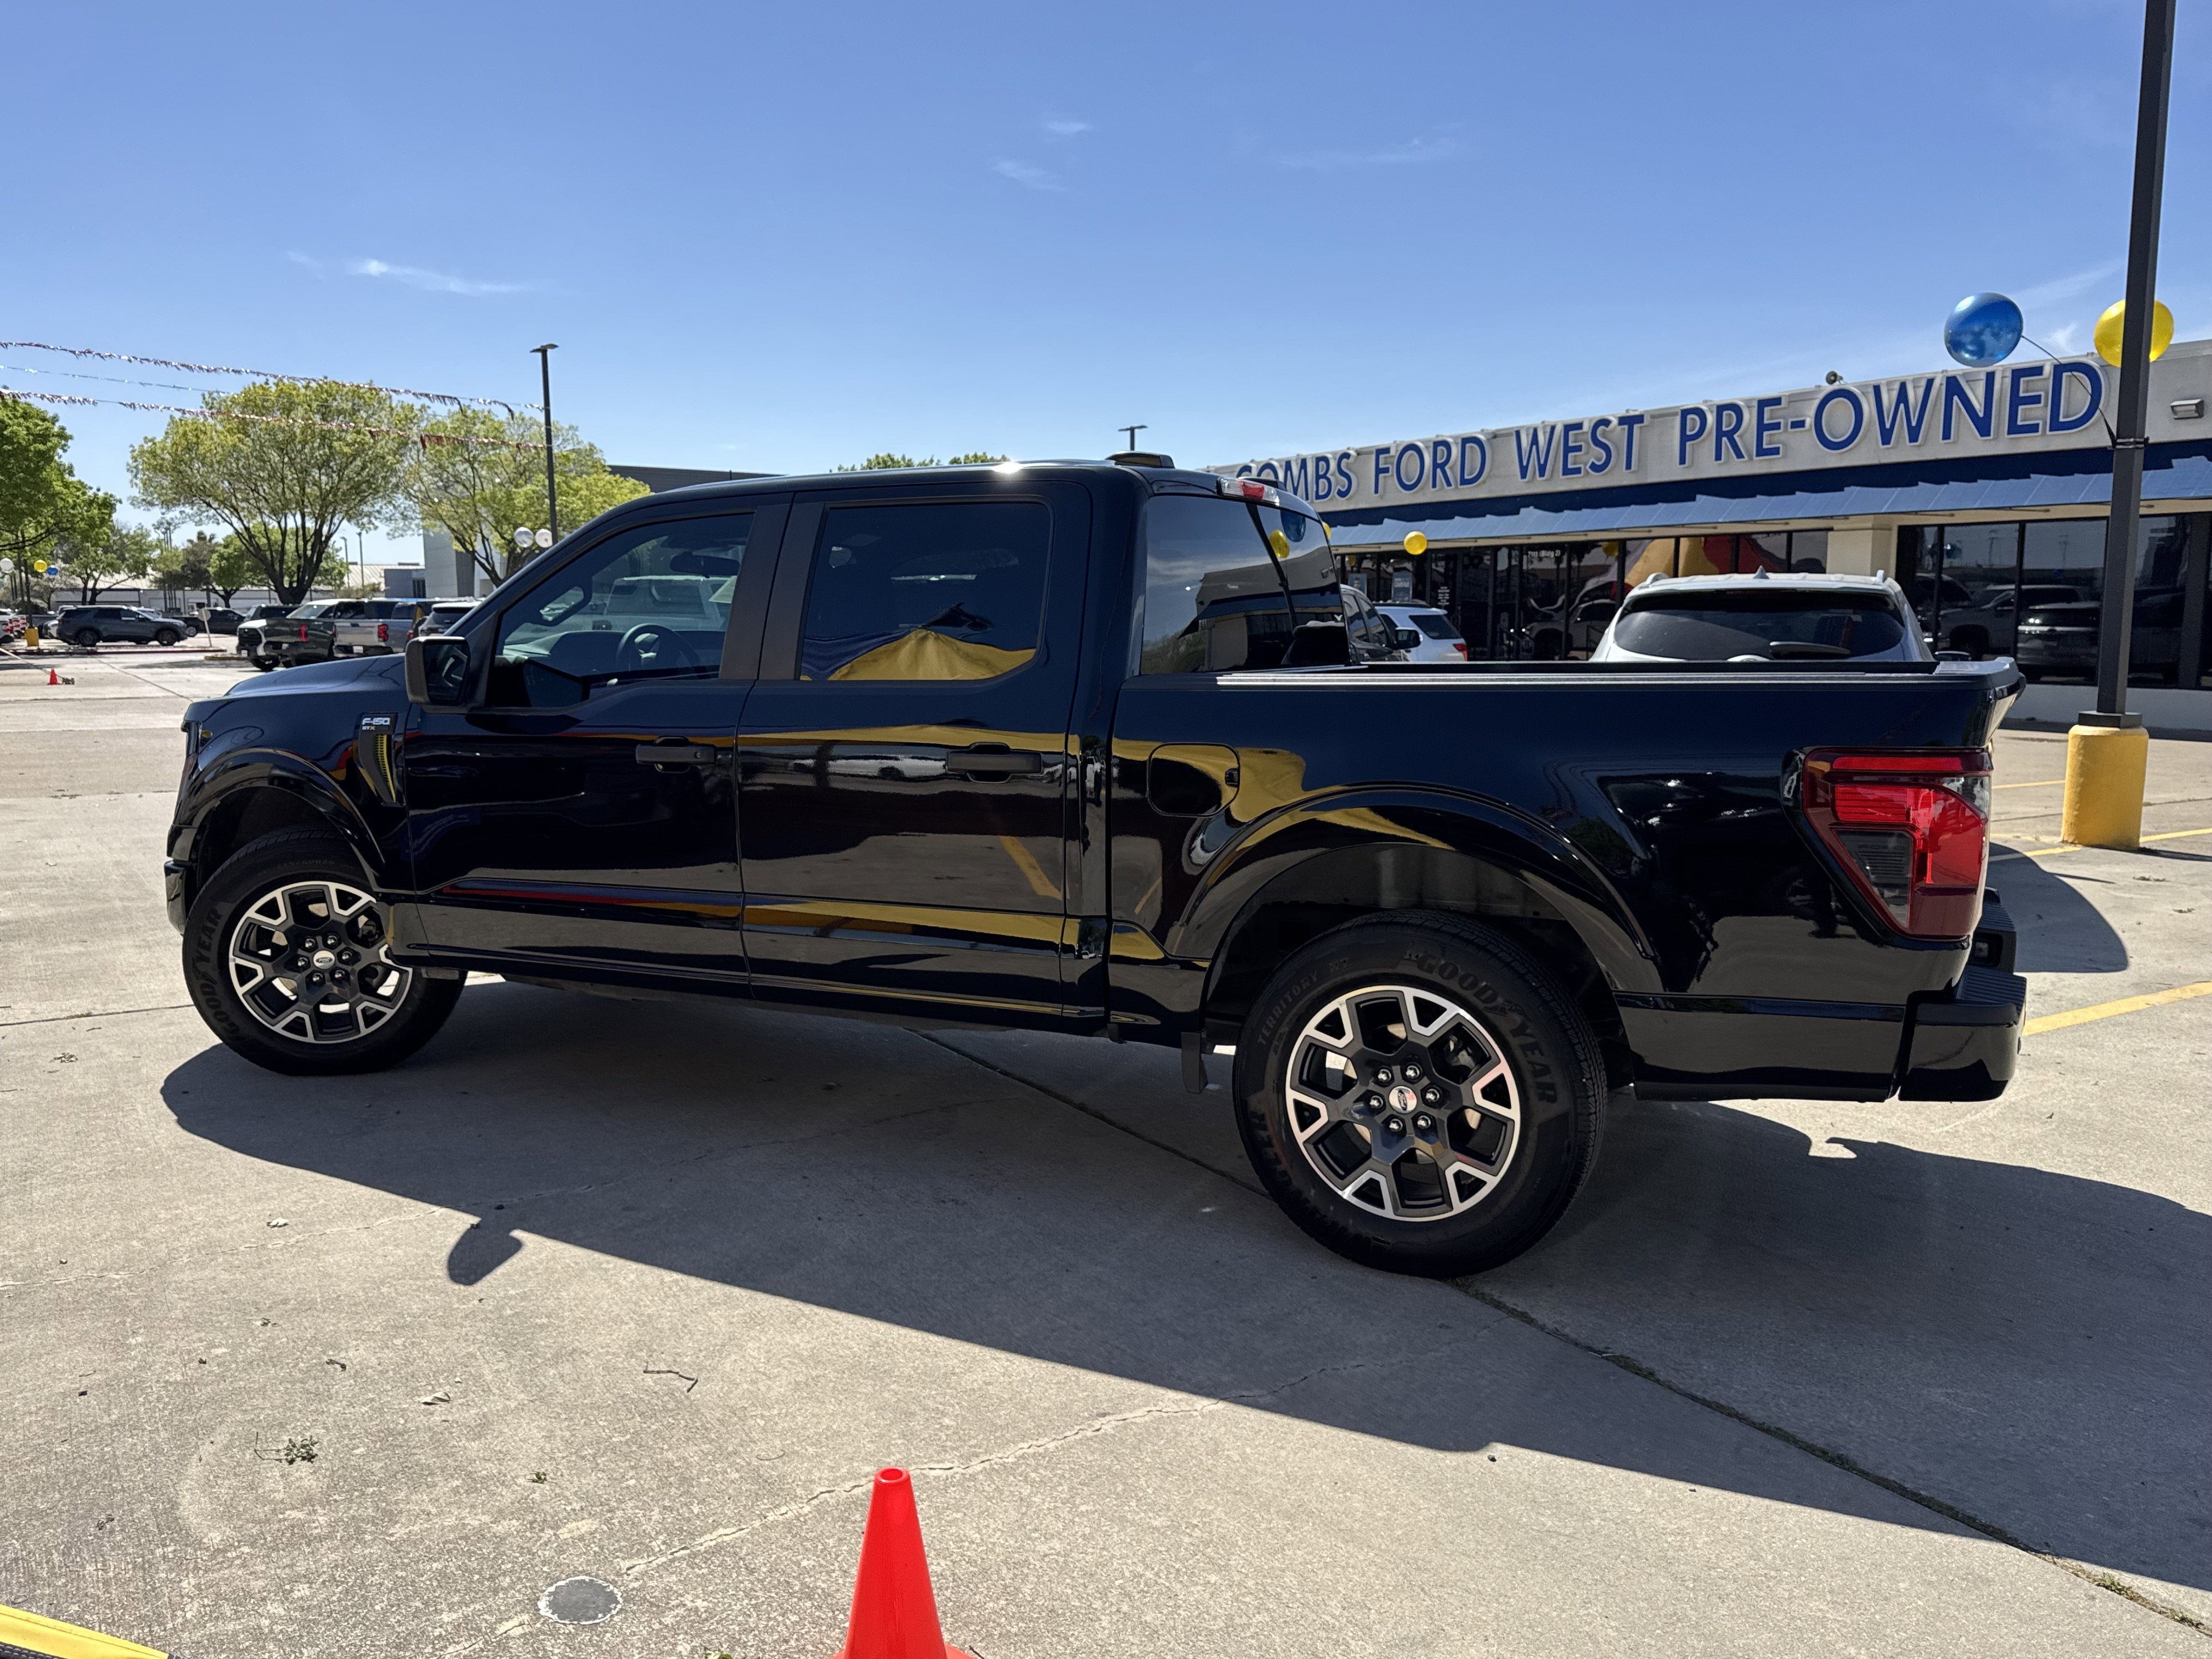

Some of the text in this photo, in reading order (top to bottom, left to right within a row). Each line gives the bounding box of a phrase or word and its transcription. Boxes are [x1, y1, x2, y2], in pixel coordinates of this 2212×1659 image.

[1373, 436, 1489, 495] FORD
[1514, 414, 1645, 481] WEST
[1678, 360, 2104, 466] PRE-OWNED
[1257, 972, 1319, 1045] TERRITORY
[1417, 957, 1558, 1104] GOODYEAR
